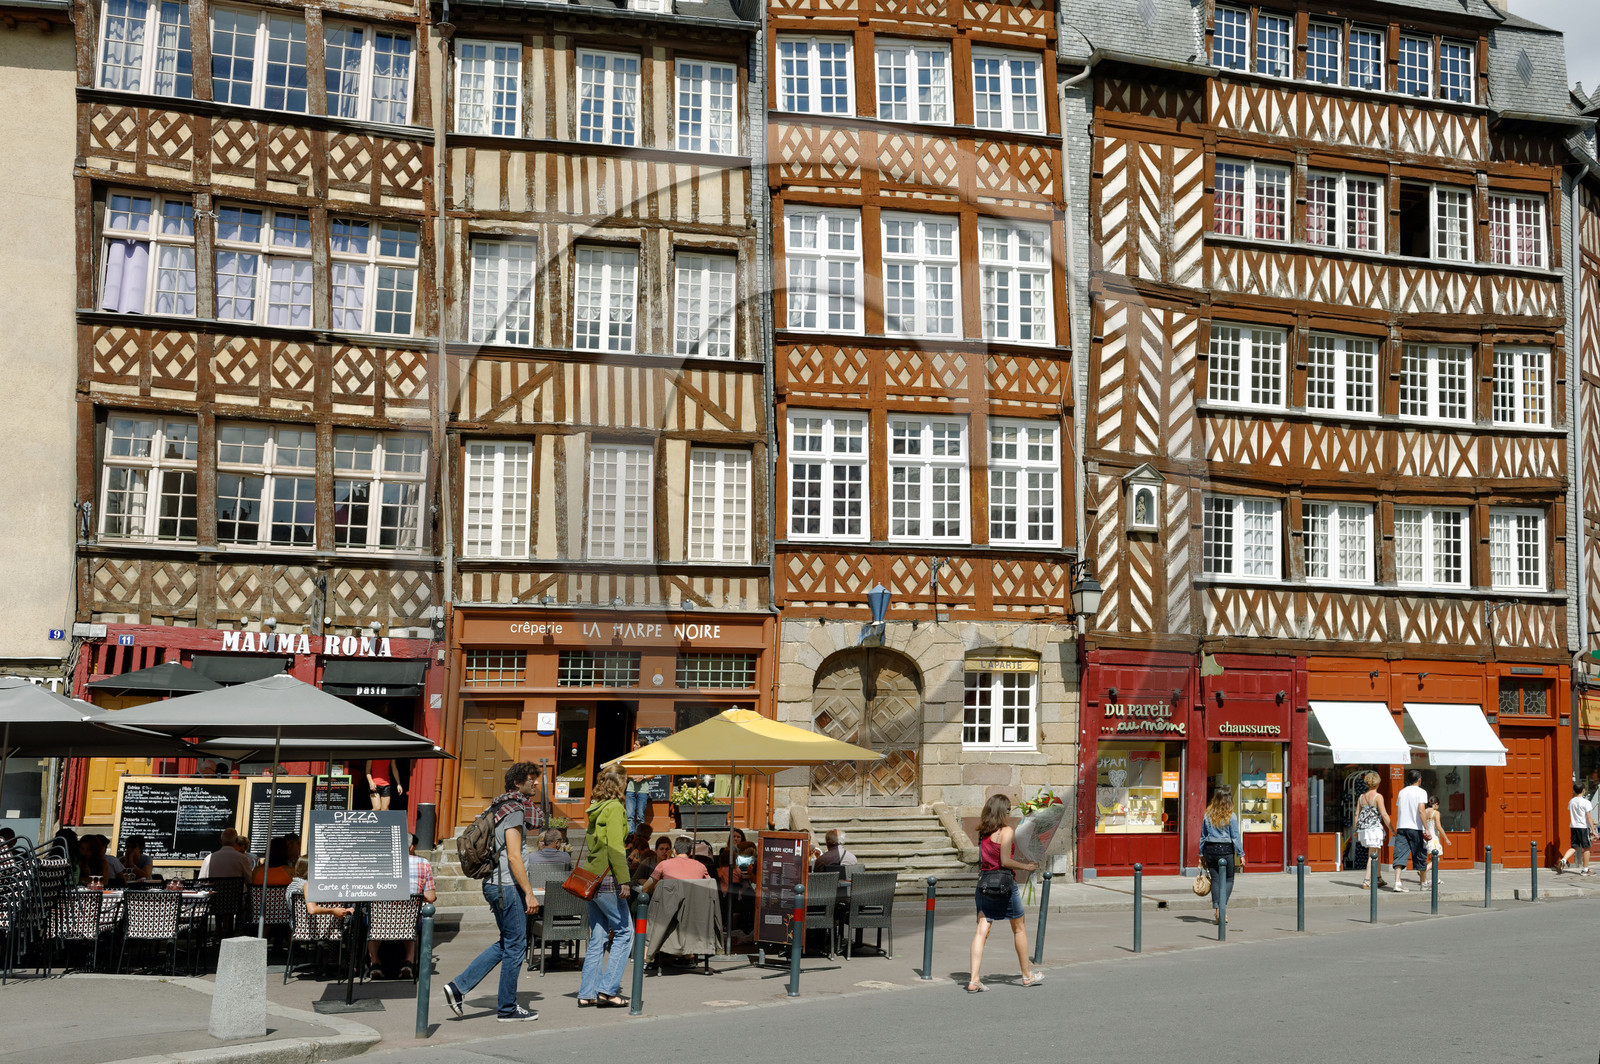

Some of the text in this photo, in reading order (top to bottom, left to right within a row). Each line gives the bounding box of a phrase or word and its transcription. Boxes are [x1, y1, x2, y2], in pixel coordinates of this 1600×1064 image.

[53, 630, 60, 639] 9
[510, 622, 721, 639] crêperie LA HARPE NOIRE
[121, 635, 132, 645] 11
[222, 631, 392, 657] MAMMA ROMA
[357, 685, 387, 696] pasta
[1116, 721, 1142, 732] au
[1140, 717, 1186, 735] même
[1219, 722, 1281, 735] chaussures
[334, 812, 378, 822] PIZZA
[376, 882, 398, 890] bistro
